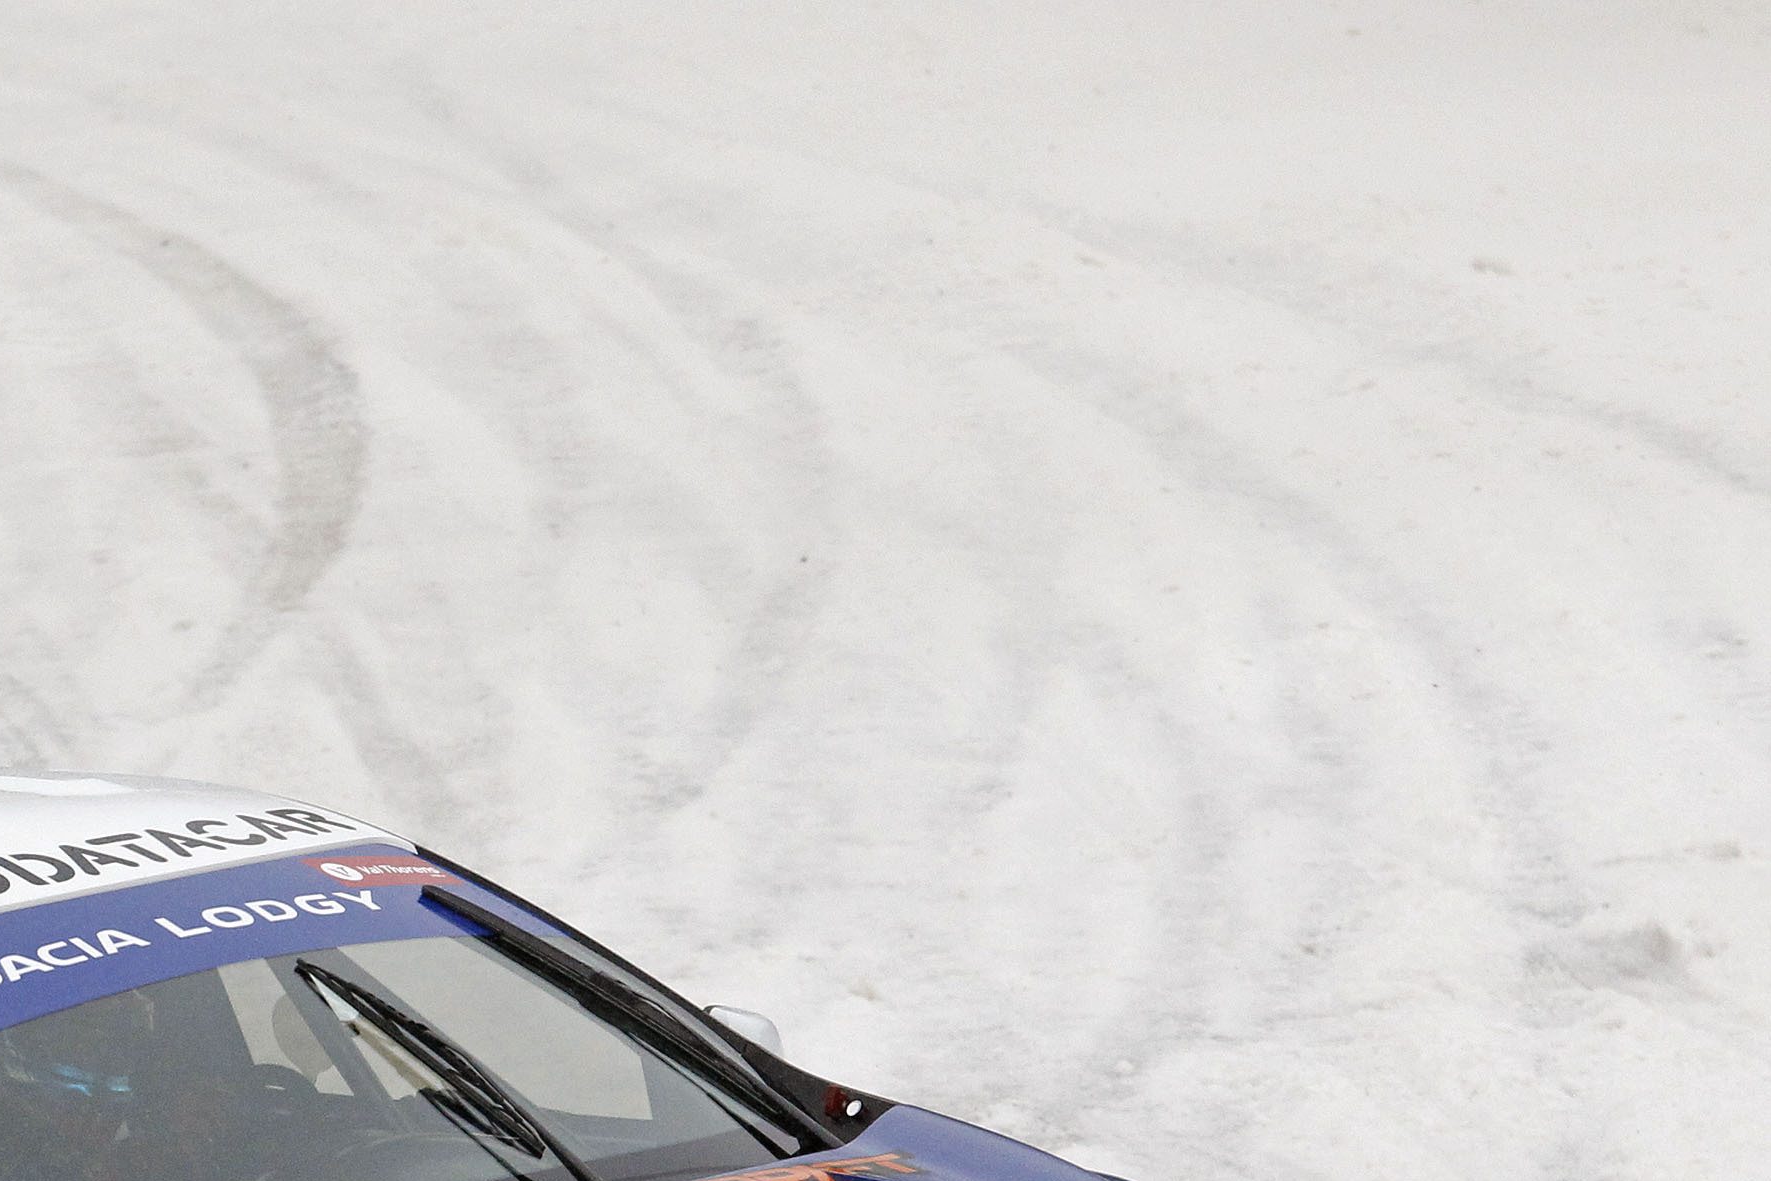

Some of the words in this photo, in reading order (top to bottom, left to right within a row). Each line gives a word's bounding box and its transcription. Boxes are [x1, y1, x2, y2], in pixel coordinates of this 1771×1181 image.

[357, 865, 383, 875] Val
[382, 864, 441, 875] Thorens
[154, 890, 383, 939] LODGY
